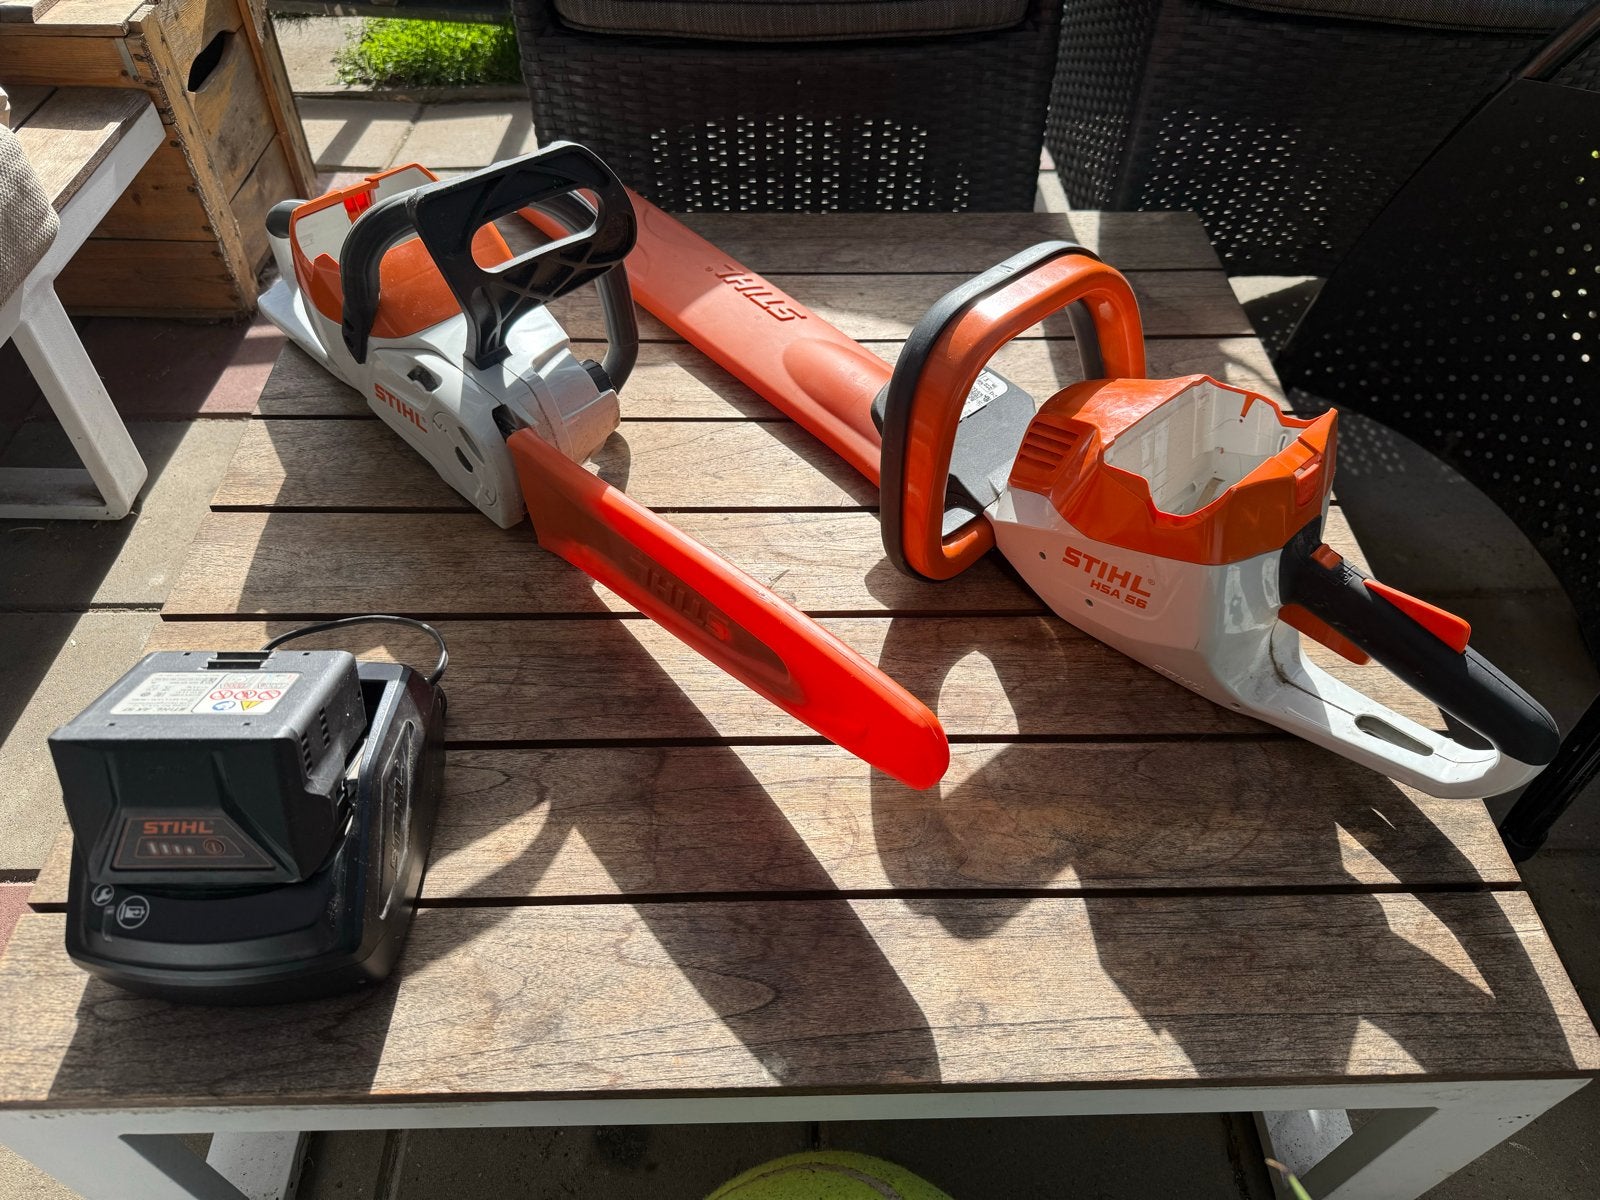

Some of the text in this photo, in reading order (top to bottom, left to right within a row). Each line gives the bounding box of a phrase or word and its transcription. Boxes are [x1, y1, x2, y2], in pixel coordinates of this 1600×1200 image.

[715, 263, 808, 322] STIHL
[374, 383, 428, 434] STIHL
[1062, 546, 1151, 598] STIHL
[1090, 579, 1148, 610] HSA 56
[143, 821, 214, 835] STIHL
